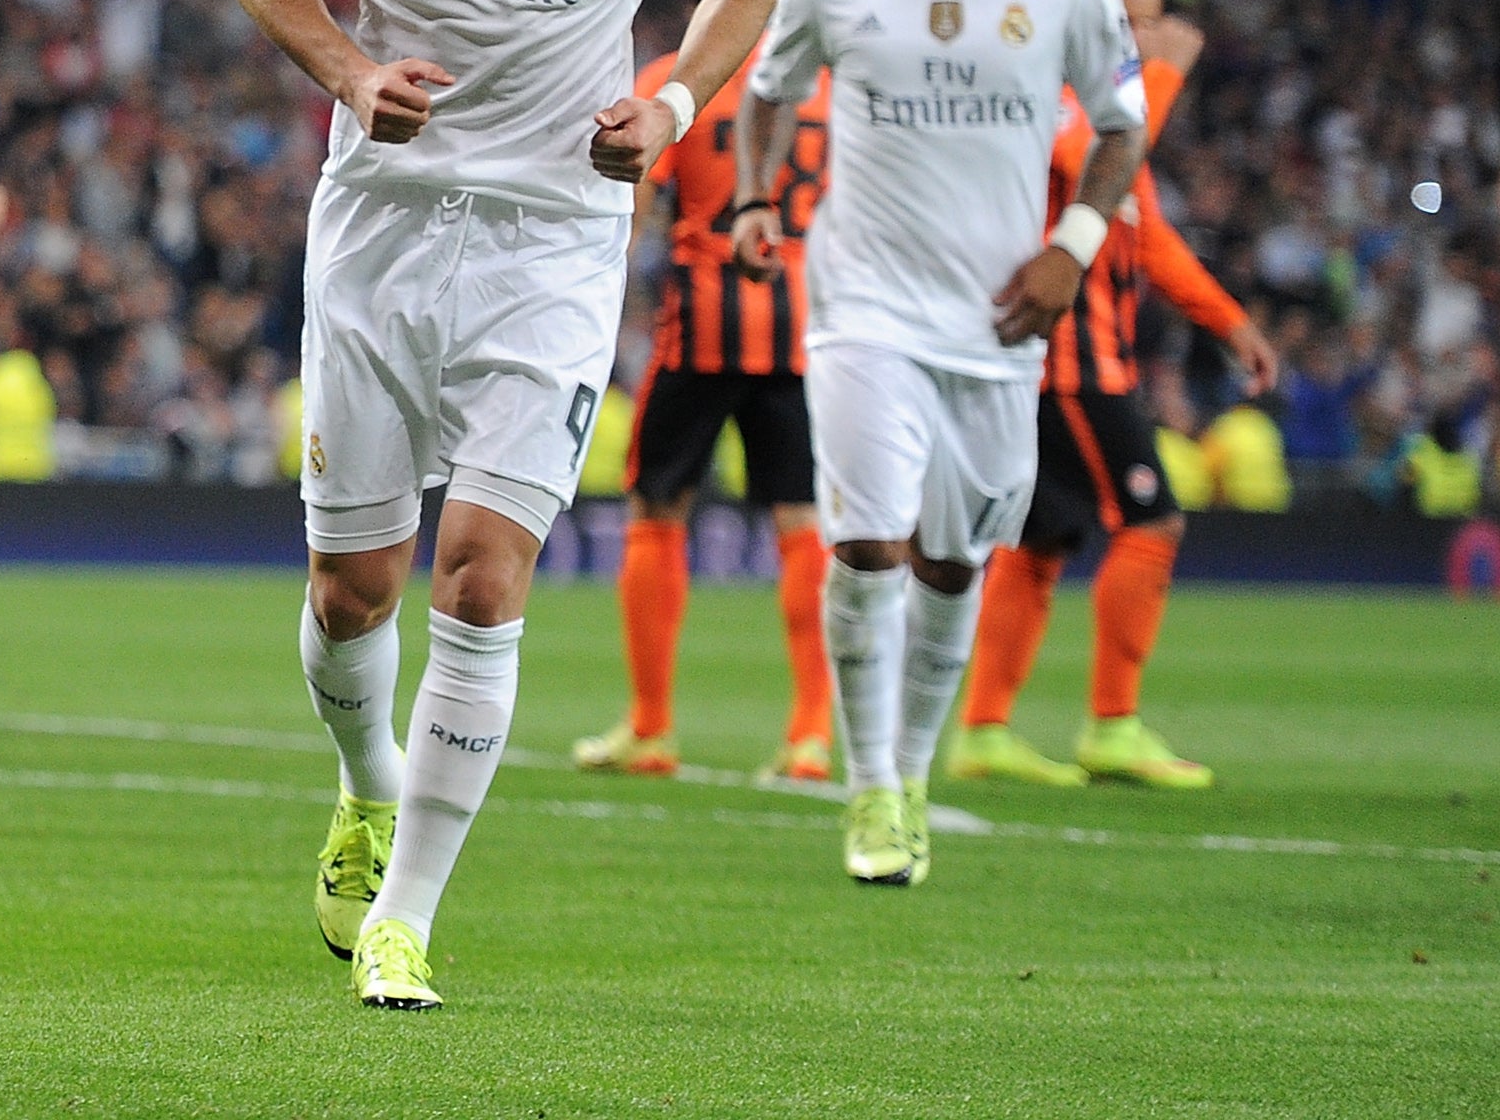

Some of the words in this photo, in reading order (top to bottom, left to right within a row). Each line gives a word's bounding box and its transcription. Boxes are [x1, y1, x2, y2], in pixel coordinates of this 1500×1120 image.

[924, 57, 977, 87] Fly
[866, 88, 1036, 127] Emirates
[566, 382, 599, 473] 9
[430, 723, 502, 752] RMCF
